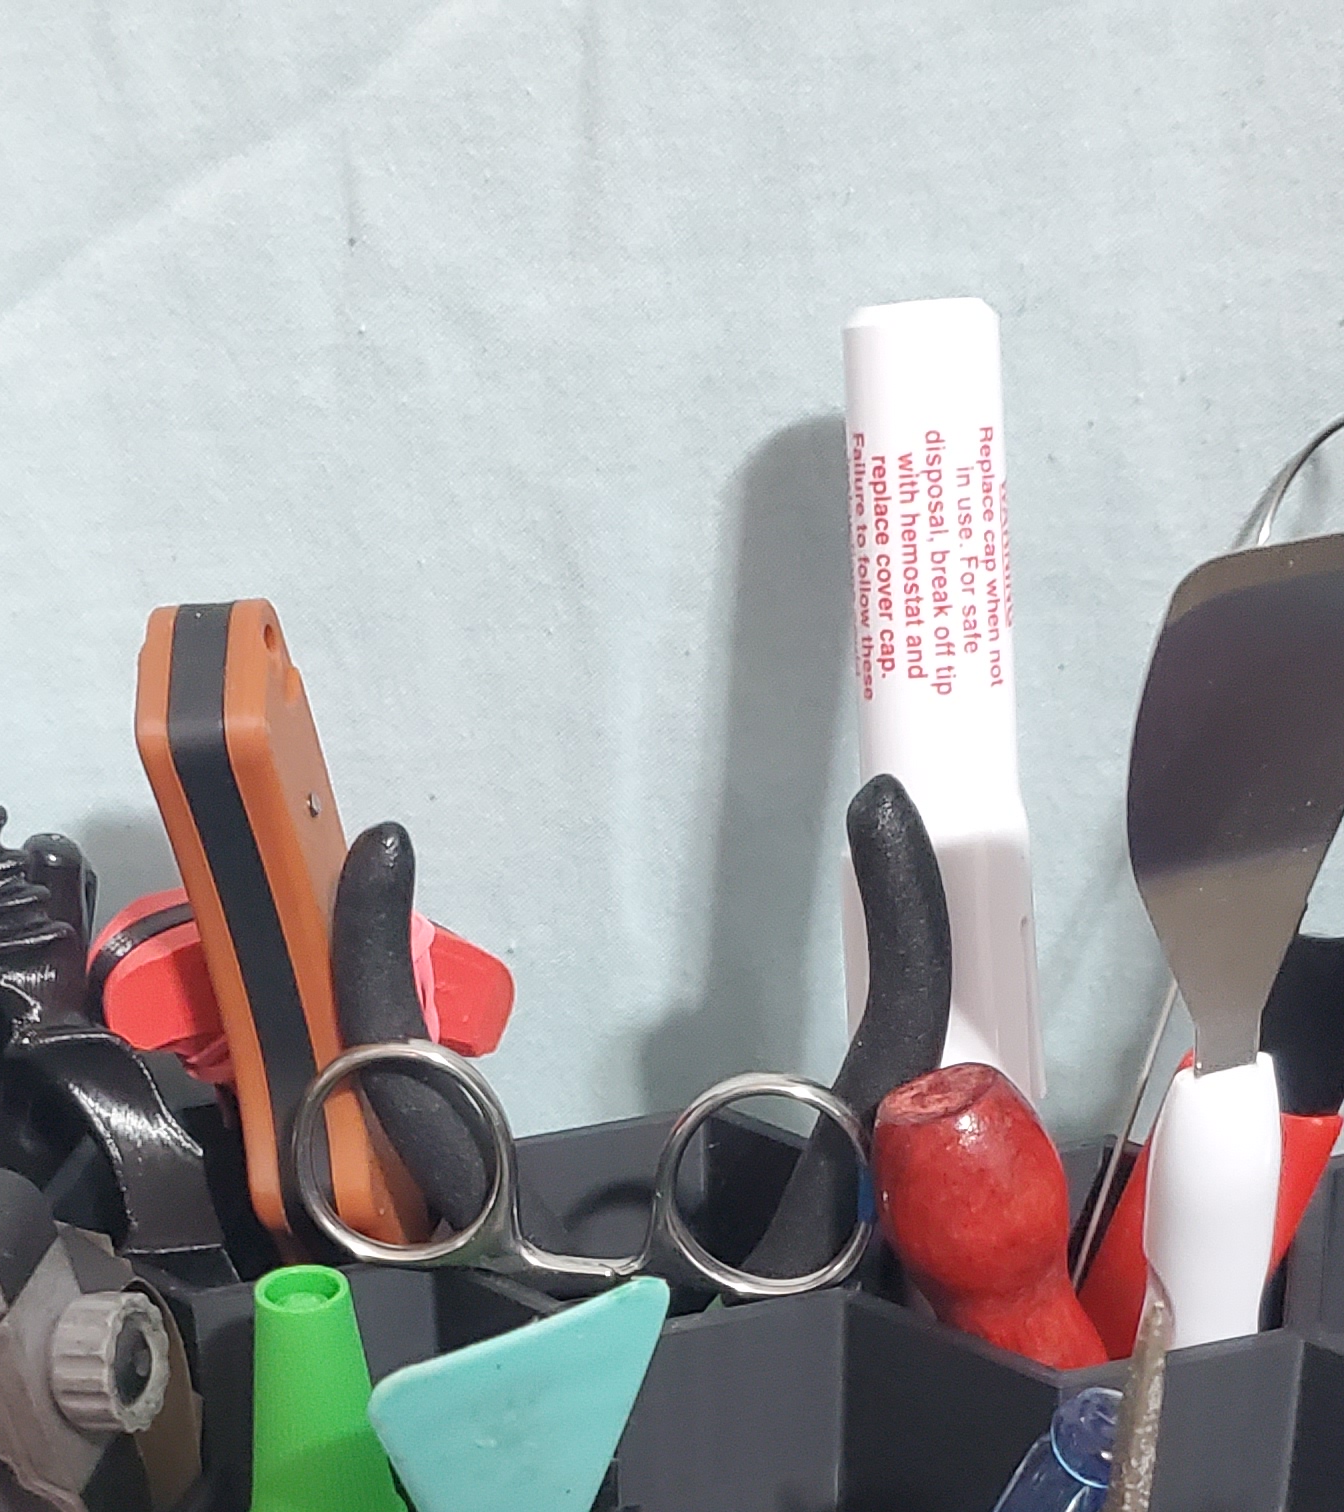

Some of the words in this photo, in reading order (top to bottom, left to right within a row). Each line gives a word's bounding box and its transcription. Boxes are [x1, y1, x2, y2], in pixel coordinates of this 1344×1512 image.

[852, 432, 866, 517] Failure
[897, 452, 920, 504] with
[920, 429, 949, 543] disposal,
[956, 466, 974, 488] in
[977, 426, 996, 522] Replace
[869, 455, 892, 545] replace
[957, 497, 973, 548] use.
[856, 523, 867, 548] to
[981, 529, 997, 572] cap
[857, 556, 871, 628] follow
[876, 554, 893, 621] cover
[900, 513, 925, 627] hemostat
[930, 550, 953, 617] break
[960, 556, 979, 596] For
[962, 605, 982, 654] safe
[986, 579, 1001, 642] when
[876, 629, 896, 678] cap.
[906, 635, 928, 679] and
[934, 625, 956, 656] off
[862, 635, 874, 701] these
[931, 665, 957, 696] tip
[990, 649, 1004, 688] not
